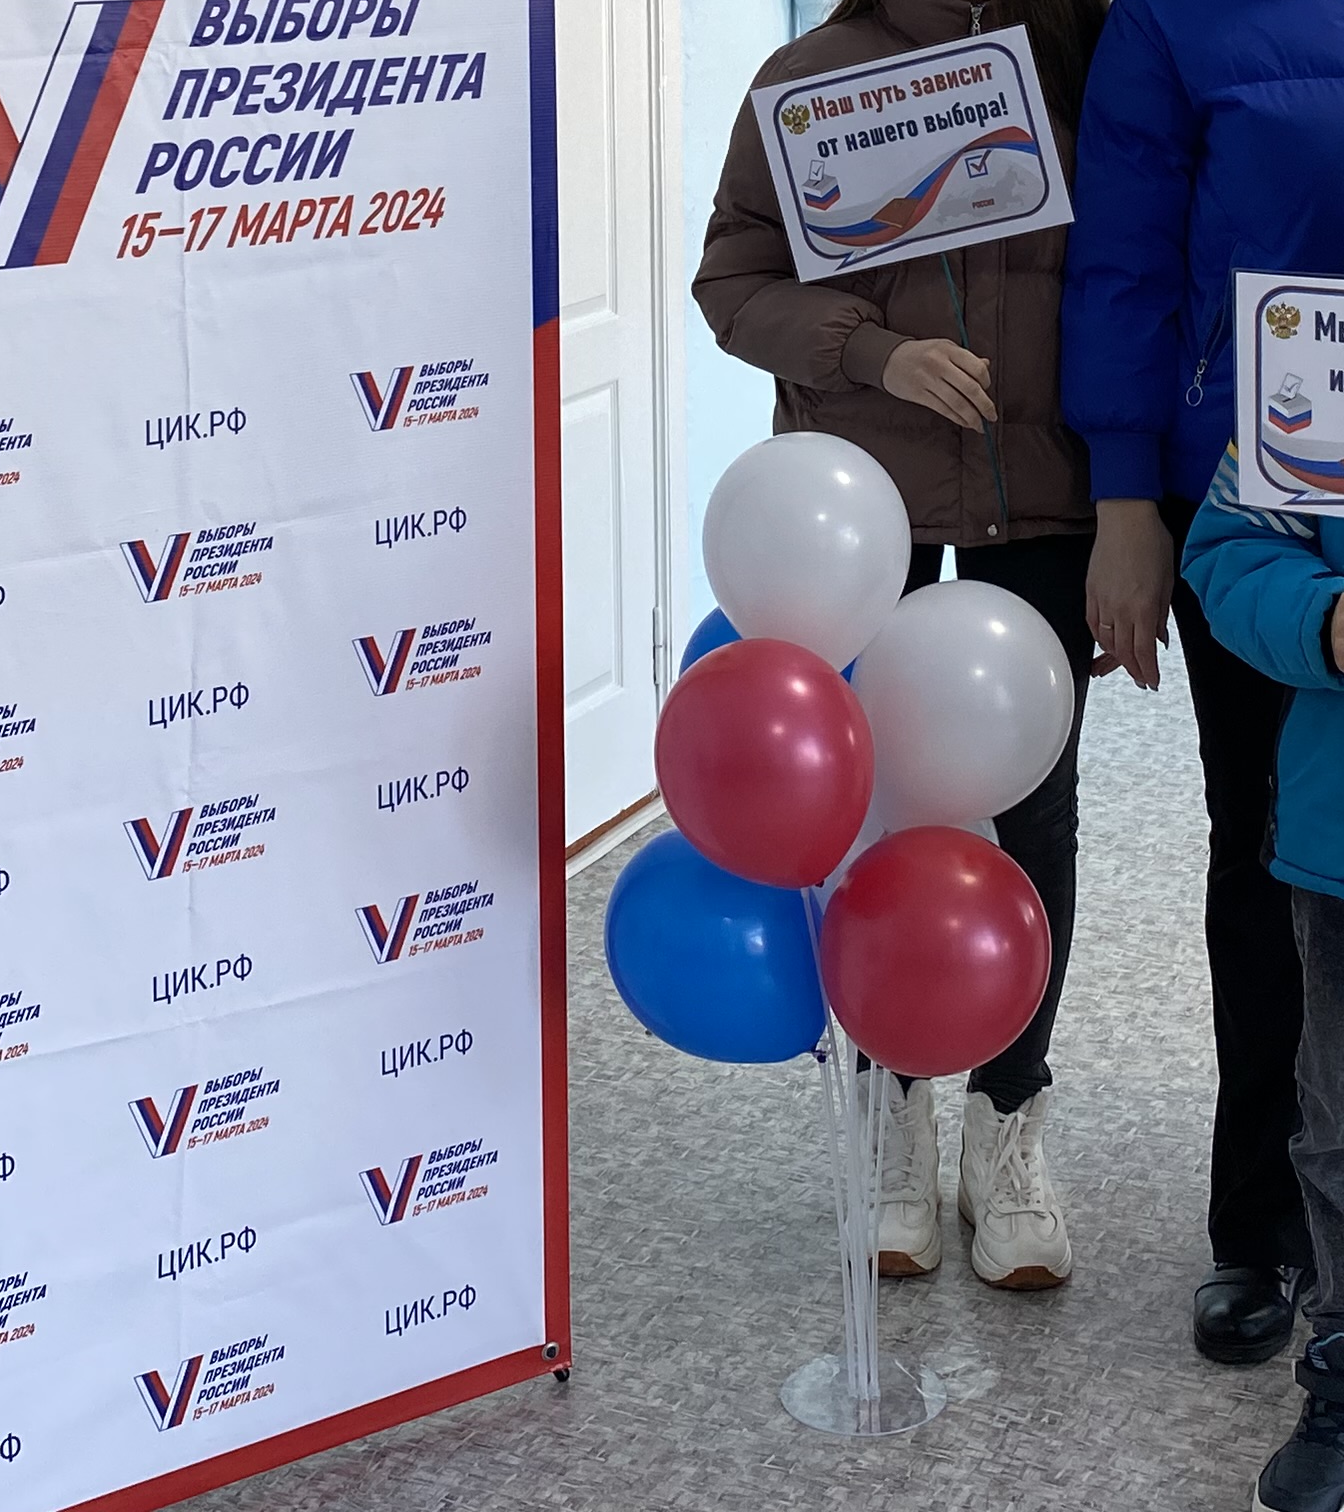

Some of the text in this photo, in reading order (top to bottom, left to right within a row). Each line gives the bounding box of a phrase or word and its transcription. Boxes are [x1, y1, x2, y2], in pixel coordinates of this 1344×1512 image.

[162, 53, 487, 121] ПРЕЗИДЕНТА
[810, 62, 993, 122] Наш путь зависит
[817, 92, 1009, 158] от нашего выбора!
[135, 129, 354, 194] РОССИИ
[227, 195, 356, 249] МАРТА
[359, 186, 445, 236] 2024
[419, 358, 474, 377] ВЫБОРЫ
[413, 373, 489, 395] ПРЕЗИДЕНТА
[408, 394, 457, 412] РОССИИ
[145, 407, 247, 450] ЦИК.РФ
[197, 522, 256, 544] ВЫБОРЫ
[375, 507, 467, 548] ЦИК.РФ
[190, 536, 274, 563] ПРЕЗИДЕНТА
[183, 560, 238, 581] РОССИИ
[422, 617, 476, 639] ВЫБОРЫ
[416, 631, 492, 657] ПРЕЗИДЕНТА
[410, 654, 459, 675] РОССИИ
[149, 682, 249, 729] ЦИК.РФ
[377, 767, 469, 812] ЦИК.РФ
[200, 794, 259, 819] ВЫБОРЫ
[193, 808, 276, 838] ПРЕЗИДЕНТА
[186, 833, 241, 857] РОССИИ
[425, 880, 478, 905] ВЫБОРЫ
[419, 893, 494, 923] ПРЕЗИДЕНТА
[413, 917, 463, 942] РОССИИ
[153, 953, 252, 1004] ЦИК.РФ
[381, 1028, 473, 1077] ЦИК.РФ
[204, 1067, 264, 1095] ВЫБОРЫ
[198, 1080, 280, 1114] ПРЕЗИДЕНТА
[191, 1107, 245, 1133] РОССИИ
[422, 1150, 498, 1183] ПРЕЗИДЕНТА
[428, 1139, 483, 1165] ВЫБОРЫ
[416, 1175, 466, 1201] РОССИИ
[437, 1191, 466, 1211] МАРТА
[466, 1185, 488, 1203] 2024
[158, 1226, 257, 1281] ЦИК.РФ
[385, 1284, 476, 1336] ЦИК.РФ
[209, 1334, 268, 1366] ВЫБОРЫ
[204, 1346, 285, 1385] ПРЕЗИДЕНТА
[197, 1374, 251, 1404] РОССИИ
